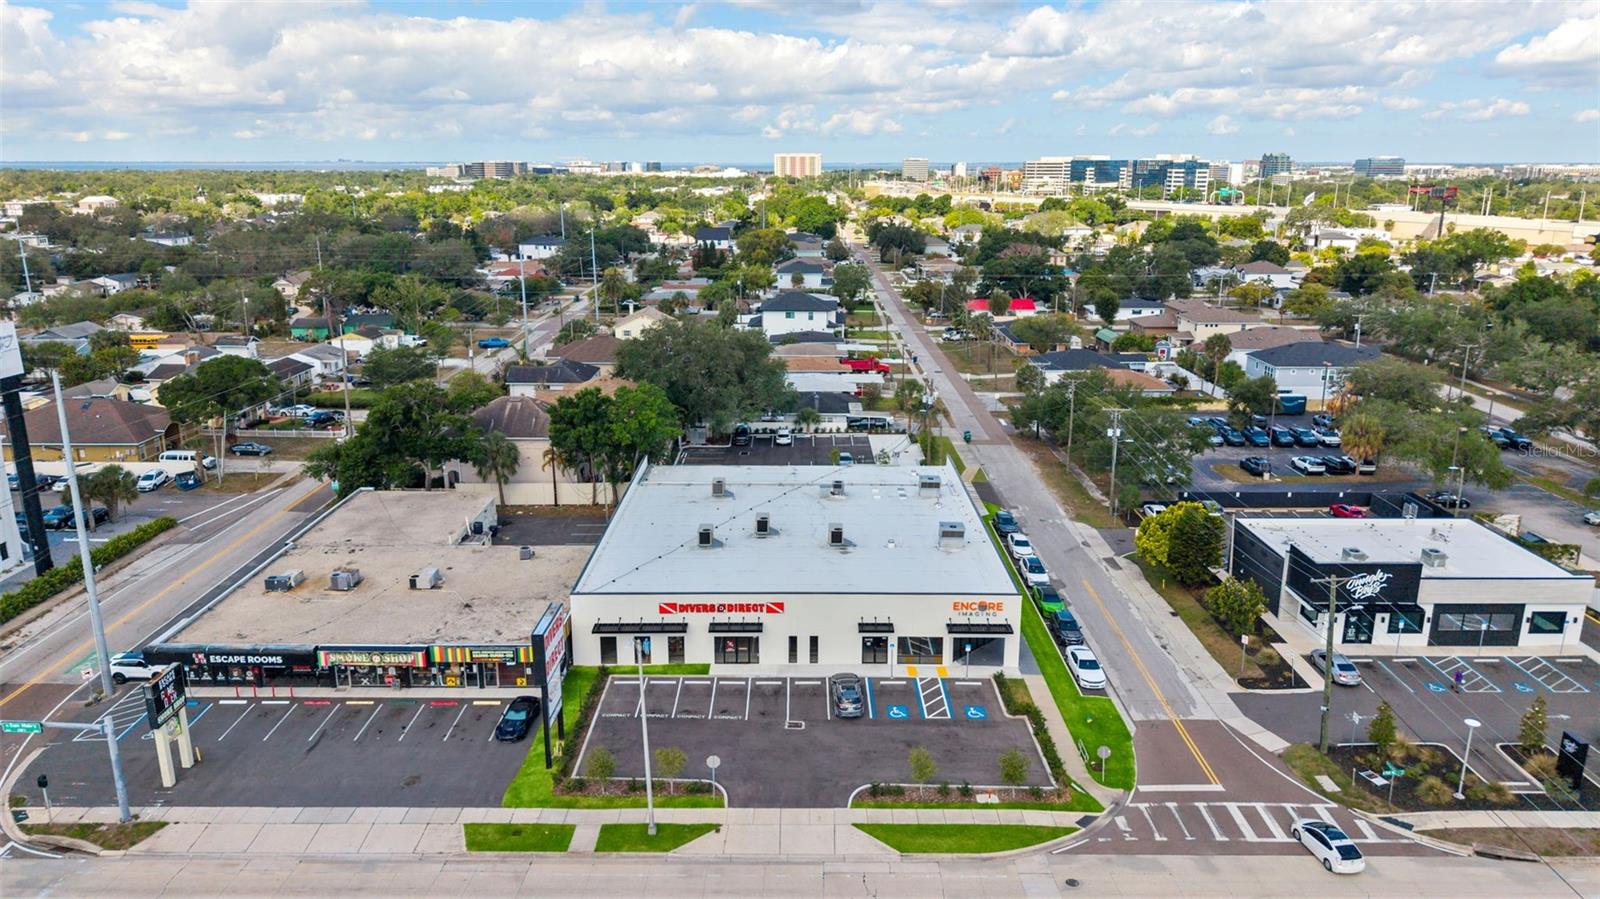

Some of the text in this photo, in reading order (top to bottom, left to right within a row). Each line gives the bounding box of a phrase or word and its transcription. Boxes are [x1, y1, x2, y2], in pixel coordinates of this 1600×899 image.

[678, 603, 765, 613] DIVERS DIRECT
[952, 601, 1004, 611] ENCORE
[209, 655, 246, 663] ESCAPE
[247, 655, 283, 664] ROOMS
[329, 652, 415, 662] SMOKE SHOP
